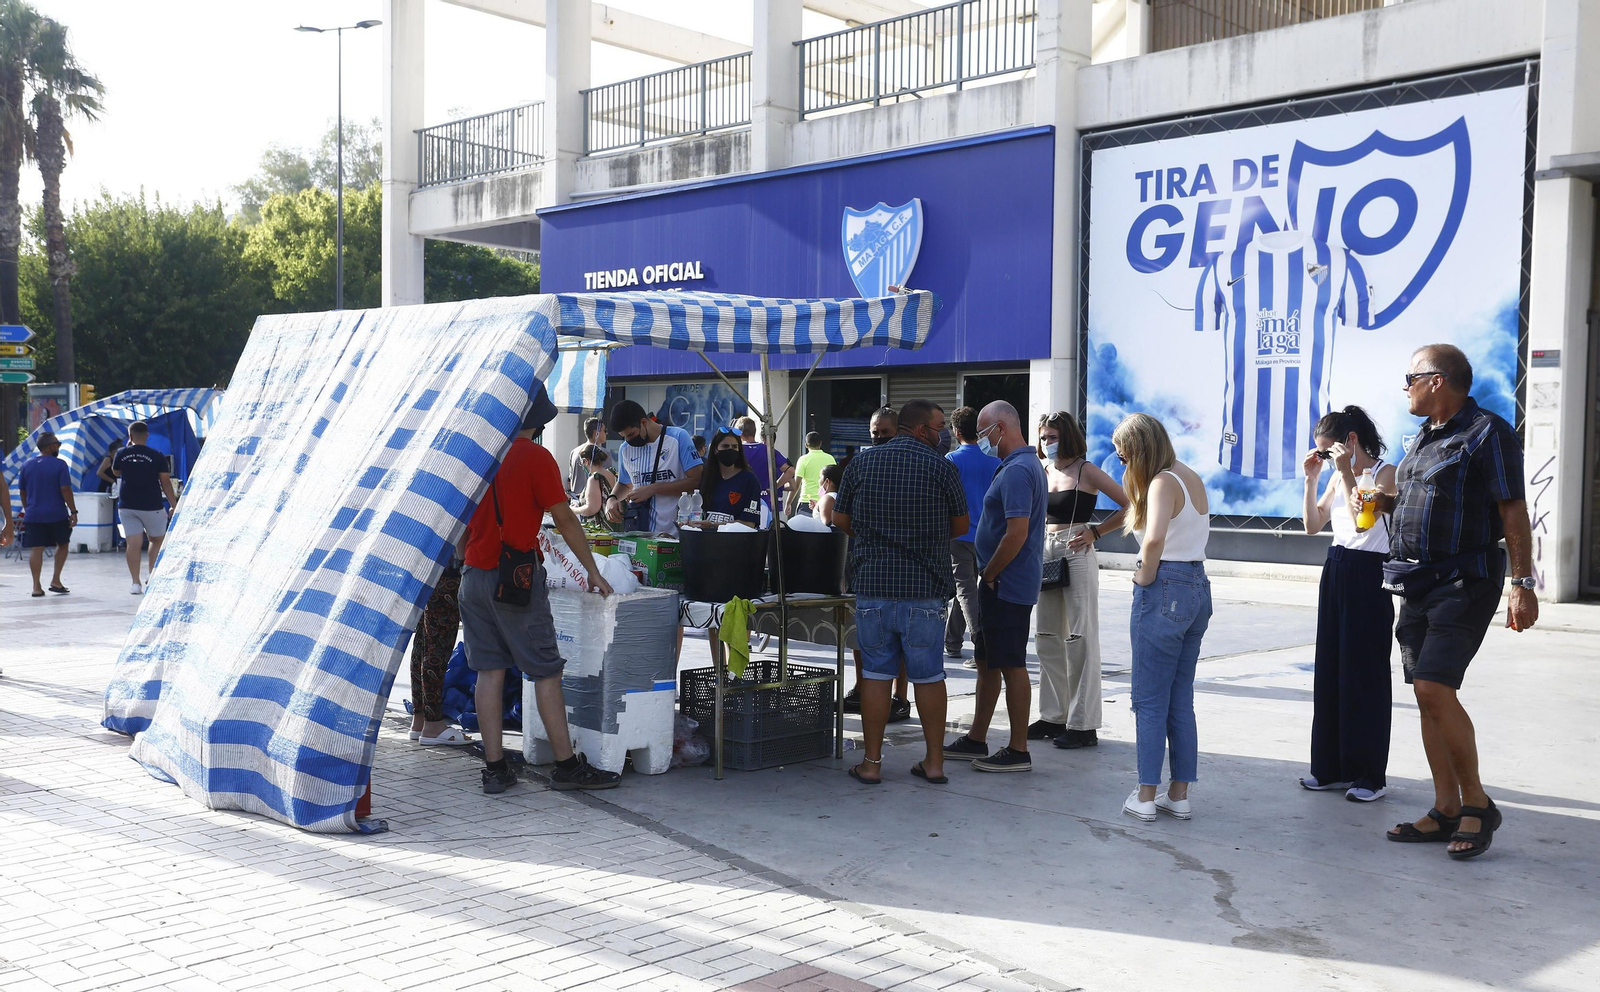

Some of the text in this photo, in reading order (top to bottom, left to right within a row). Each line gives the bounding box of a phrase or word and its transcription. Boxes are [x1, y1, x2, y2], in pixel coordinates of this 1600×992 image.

[1135, 154, 1280, 203] TIRA DE
[584, 260, 704, 290] TIENDA OFICIAL
[641, 469, 676, 483] TEESA
